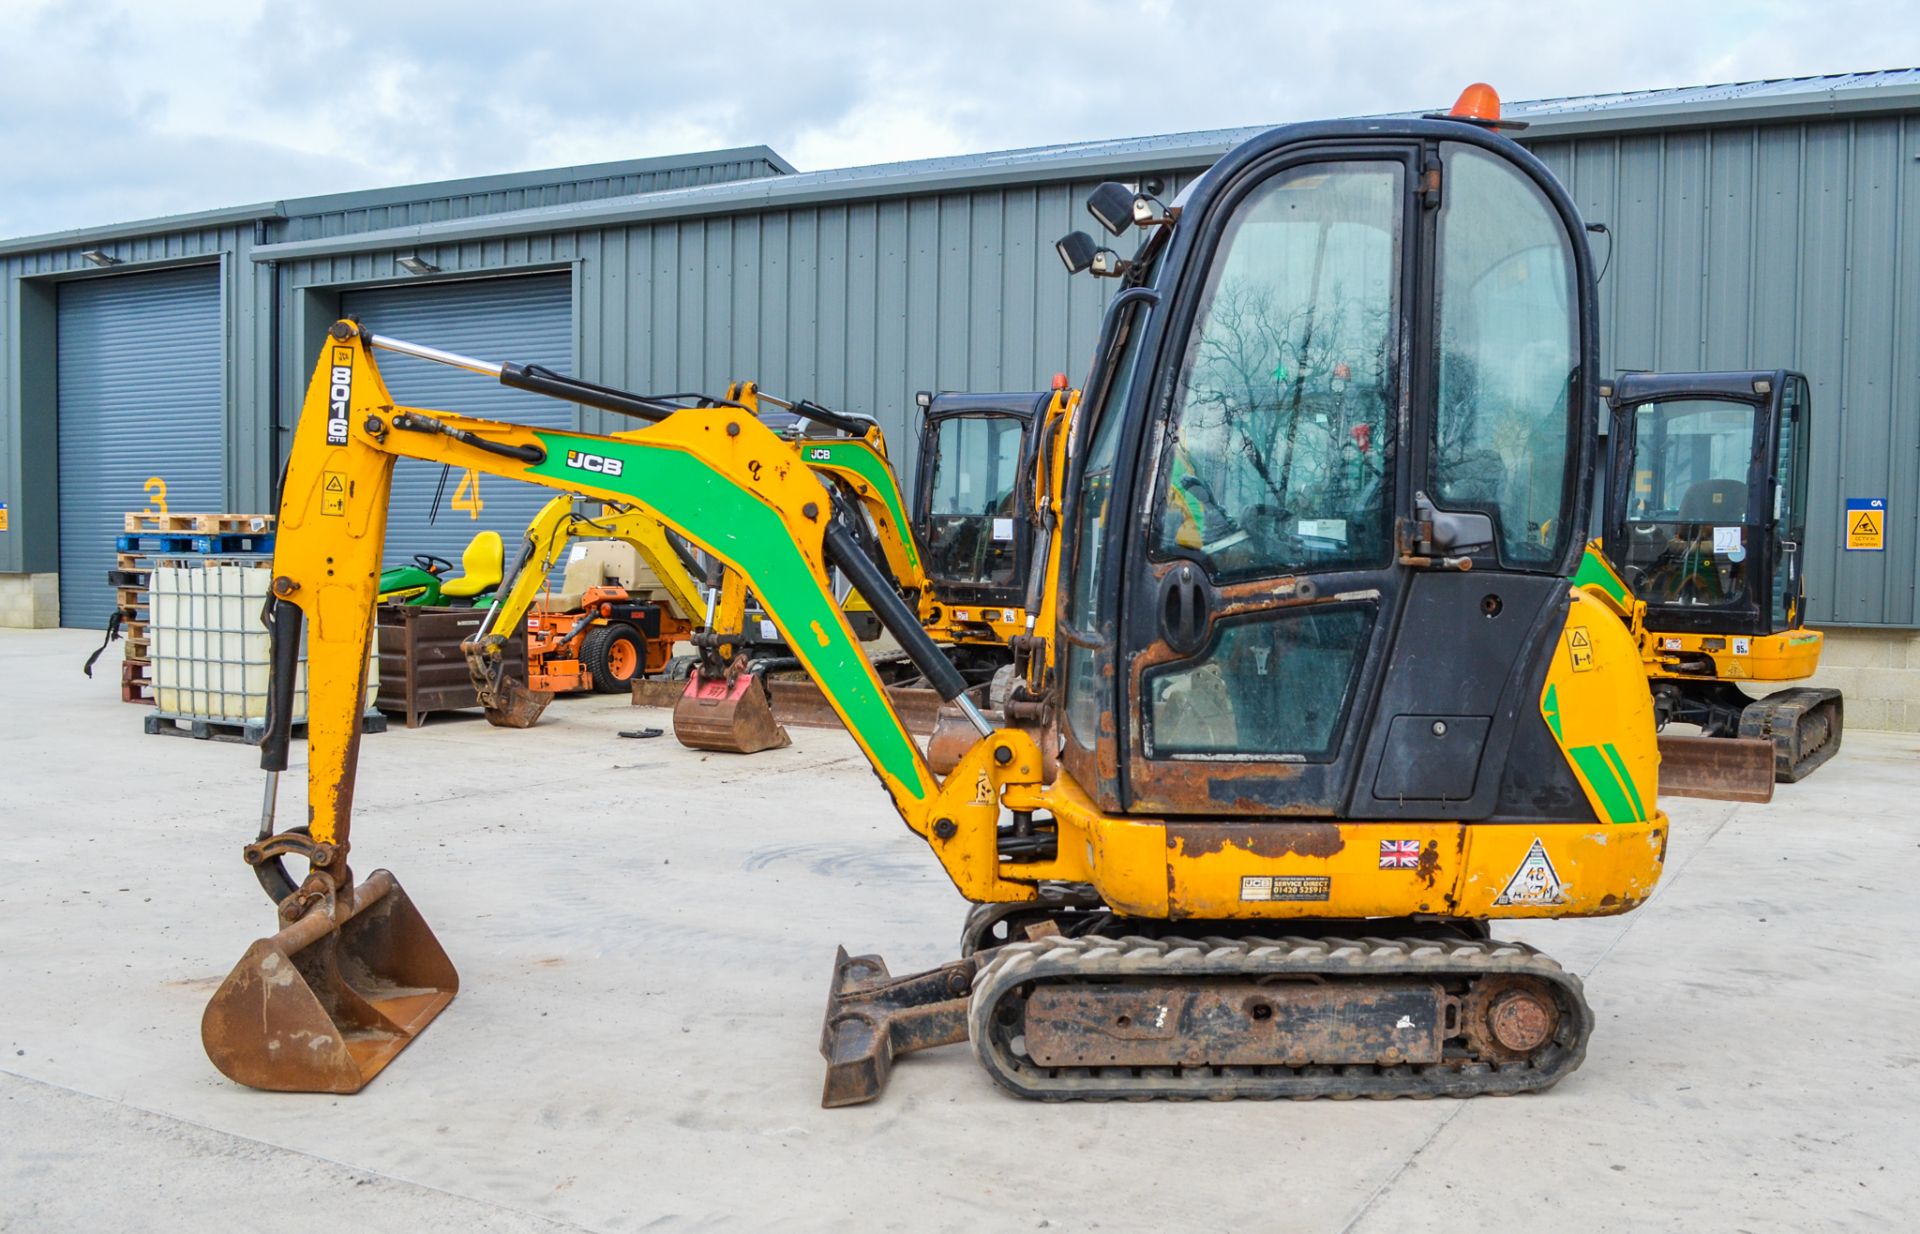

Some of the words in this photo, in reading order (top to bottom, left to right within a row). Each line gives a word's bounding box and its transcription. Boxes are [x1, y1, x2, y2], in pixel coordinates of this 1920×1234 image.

[328, 367, 351, 437] 8016
[567, 452, 623, 476] JCB
[811, 448, 831, 460] JCB
[143, 476, 168, 523] 3
[452, 466, 484, 521] 4
[1245, 879, 1271, 887] JCB
[1273, 886, 1299, 894] 01420
